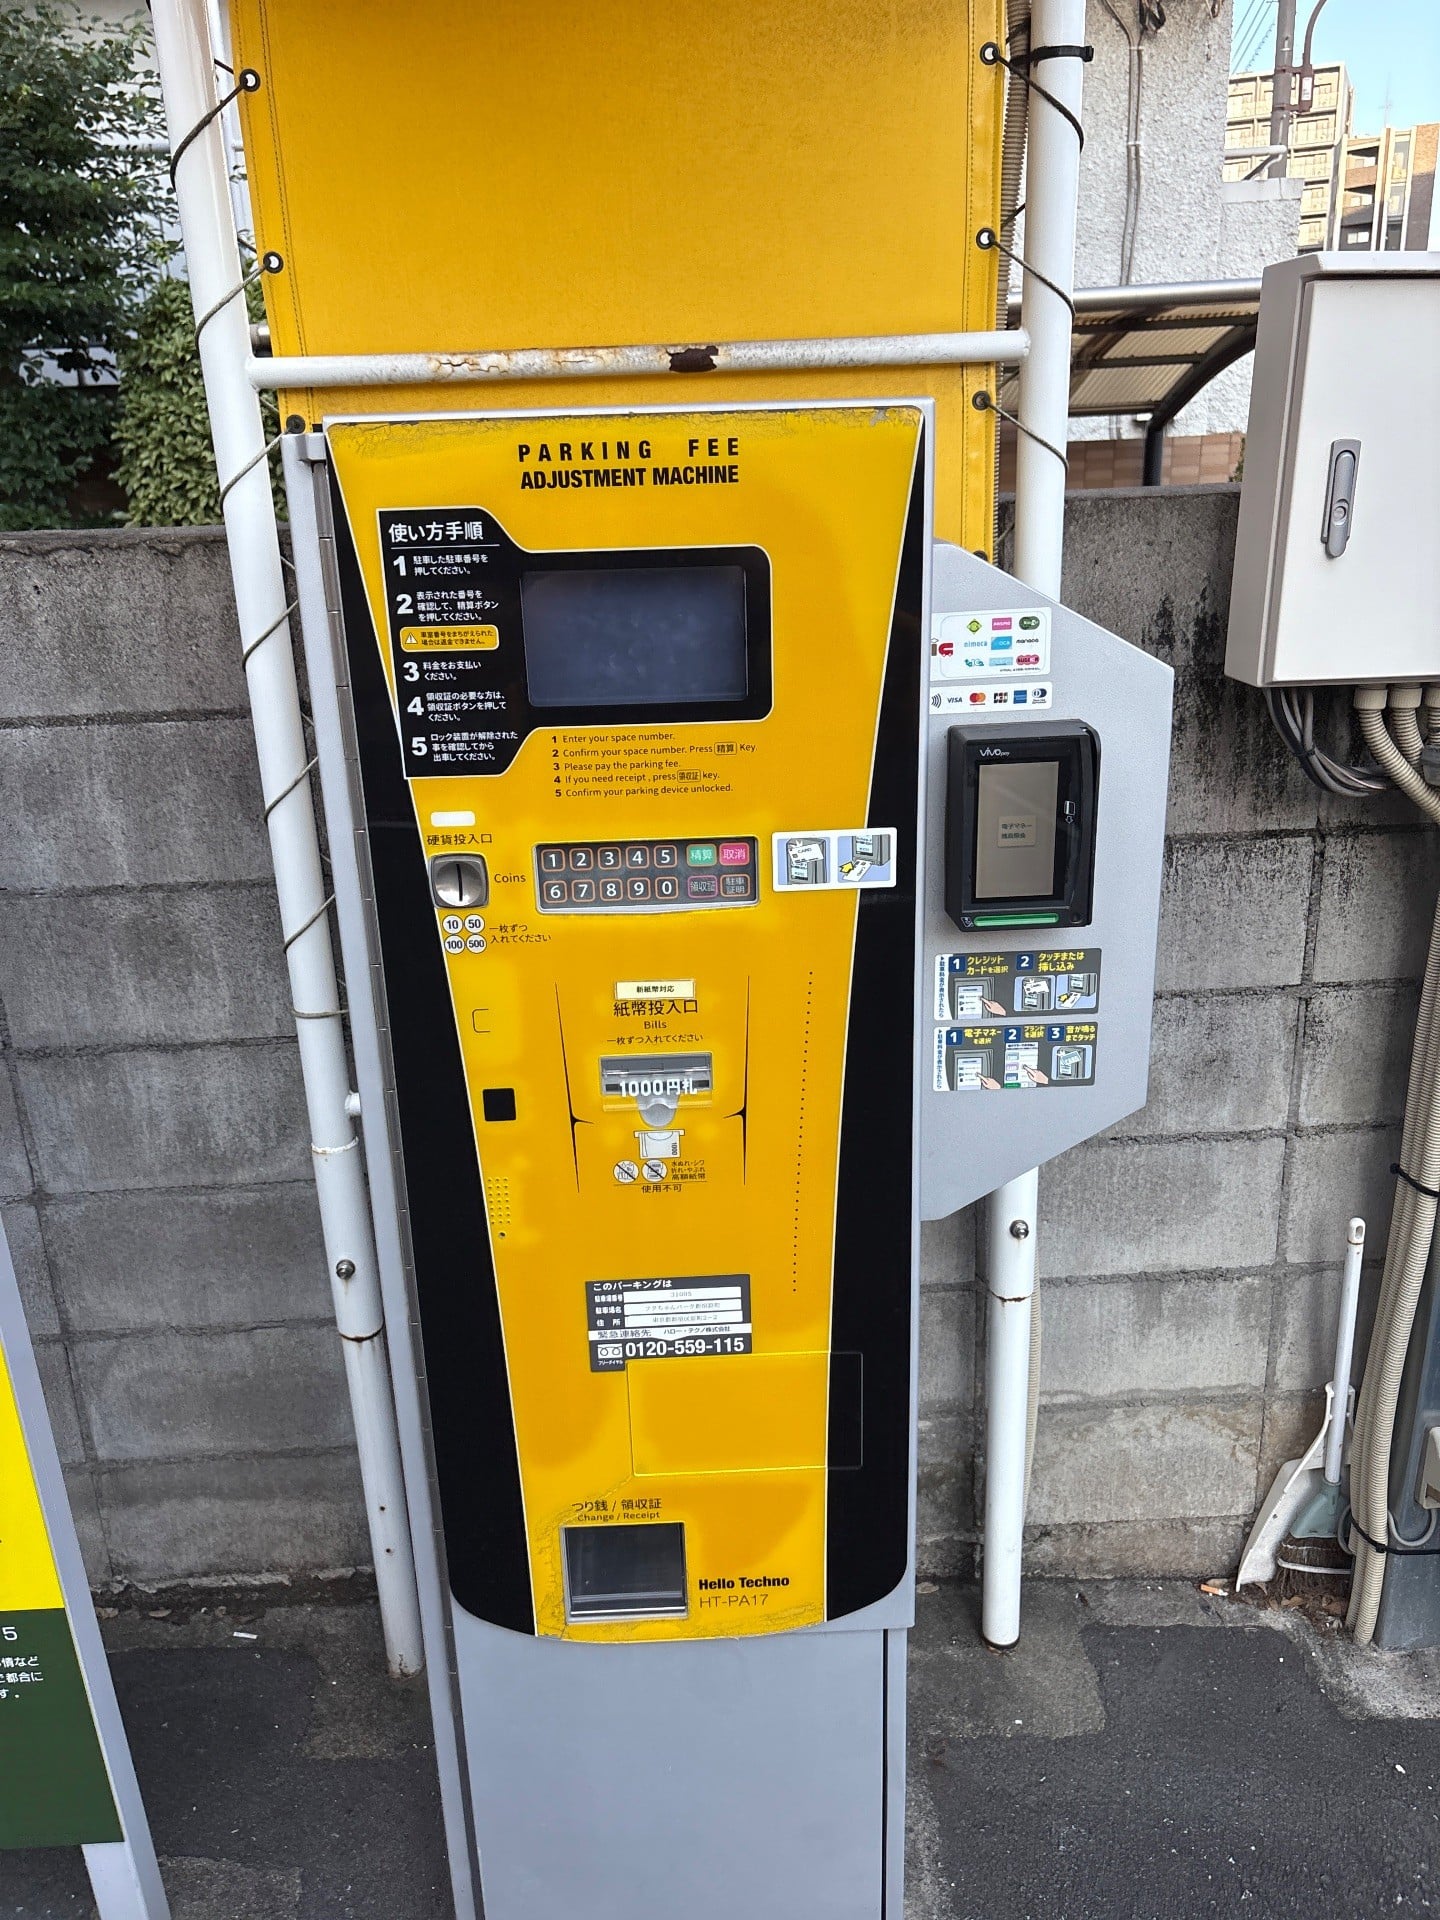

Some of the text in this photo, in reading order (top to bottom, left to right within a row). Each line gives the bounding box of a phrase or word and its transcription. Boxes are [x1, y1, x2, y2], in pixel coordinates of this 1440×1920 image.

[518, 438, 738, 462] PARKING FEE
[521, 465, 738, 489] ADJUSTMENT MACHINE
[388, 522, 483, 542] 使い方手順
[394, 554, 488, 576] 1 駐車した駐車番号を
[414, 567, 470, 576] 押してください。
[396, 591, 482, 614] 2 表示された番号を
[418, 601, 498, 611] 確認して、精算ボタン
[419, 613, 481, 622] を押してください。
[403, 661, 481, 681] 3 料金をお支払い
[407, 691, 505, 716] 4 領収証の必要な方は、
[427, 702, 506, 711] 領収証ボタンを押して
[412, 732, 518, 756] 5 ロック装置が解除された
[563, 735, 586, 743] Enter
[589, 736, 609, 744] your
[611, 734, 636, 743] space
[638, 732, 675, 741] number.
[432, 742, 494, 751] 事を確認してから
[563, 749, 598, 757] Confirm
[601, 749, 621, 758] your
[624, 748, 648, 756] space
[650, 746, 687, 754] number.
[690, 745, 712, 753] Press
[740, 743, 757, 752] Key.
[434, 753, 495, 761] 出車してください。
[554, 760, 680, 772] 3 Please pay the parking fee.
[566, 775, 572, 783] If
[574, 776, 589, 785] you
[653, 773, 676, 782] press
[703, 771, 720, 780] key.
[566, 788, 601, 797] Confirm
[604, 789, 624, 798] your
[625, 786, 659, 796] parking
[661, 785, 687, 793] device
[691, 784, 733, 792] unlocked.
[427, 834, 492, 845] 硬貨投入口
[549, 848, 745, 867] 1 2 3 4 5 精算 取消
[494, 874, 526, 882] Coins
[550, 885, 560, 898] 6
[578, 884, 588, 897] 7
[606, 883, 616, 896] 8
[634, 882, 644, 895] 9
[662, 881, 672, 895] 0
[447, 919, 480, 929] 10 50
[447, 940, 484, 949] 100 500
[491, 934, 551, 944] 入れてください
[953, 956, 1005, 969] 1 クレジット
[1021, 952, 1084, 967] 2 タッチまたは
[967, 966, 1008, 975] カードを選択
[1038, 962, 1074, 972] 挿し込み
[614, 999, 698, 1017] 紙幣投入口
[644, 1021, 666, 1029] Bills
[951, 1029, 1001, 1042] 1 電子マネー
[1009, 1030, 1016, 1040] 2
[1052, 1028, 1059, 1038] 3
[1066, 1034, 1095, 1042] までタッチ
[607, 1034, 703, 1045] 一枚ずつ入れてください
[641, 1184, 682, 1193] 使用不可
[593, 1280, 672, 1291] このパーキングは
[598, 1326, 730, 1338] 緊急連絡先 ハロー・テクノ株式会社
[626, 1338, 744, 1357] 0120-559-115
[572, 1500, 608, 1512] つり銭
[621, 1498, 662, 1510] 領収証
[578, 1513, 614, 1521] Change
[624, 1512, 659, 1520] Receipt
[699, 1576, 789, 1590] Hello Techno
[700, 1594, 768, 1609] HT-PA17
[0, 1656, 40, 1668] 情など
